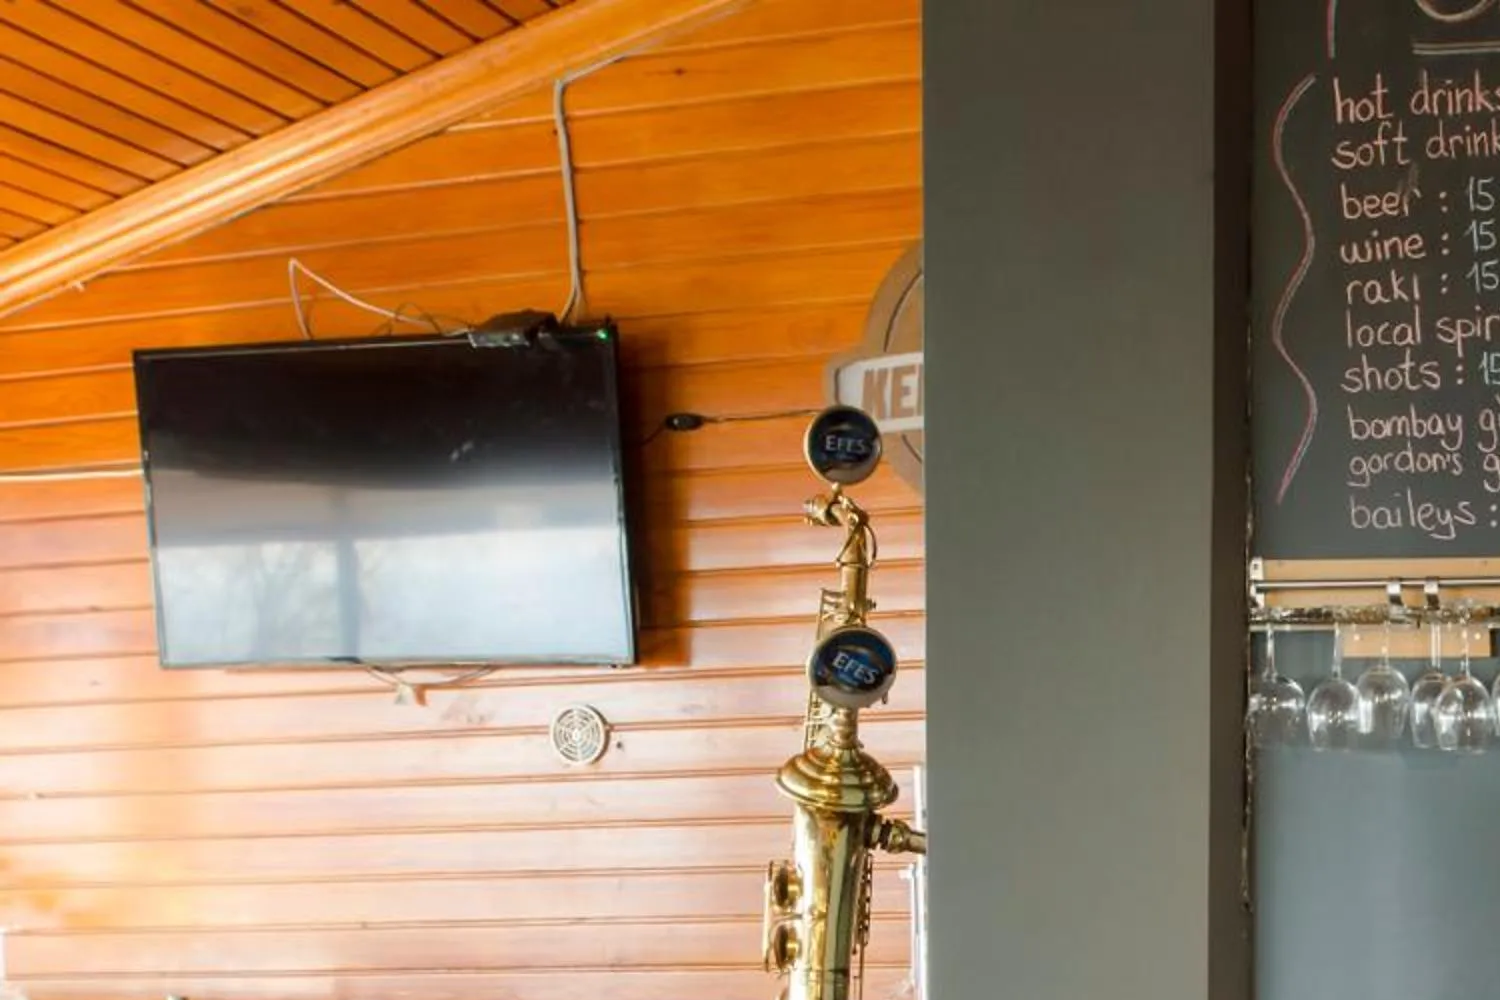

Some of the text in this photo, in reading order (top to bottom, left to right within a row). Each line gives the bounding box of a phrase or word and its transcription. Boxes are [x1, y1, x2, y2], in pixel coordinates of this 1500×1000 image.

[1333, 72, 1393, 125] hot
[1331, 122, 1411, 170] soft
[1340, 182, 1421, 219] beer
[1340, 229, 1426, 264] wine
[1346, 304, 1422, 348] local
[861, 364, 923, 421] KE
[1340, 348, 1442, 393] shots
[1347, 403, 1463, 450] bombay
[1350, 486, 1477, 540] baileys
[832, 651, 879, 685] EFES
